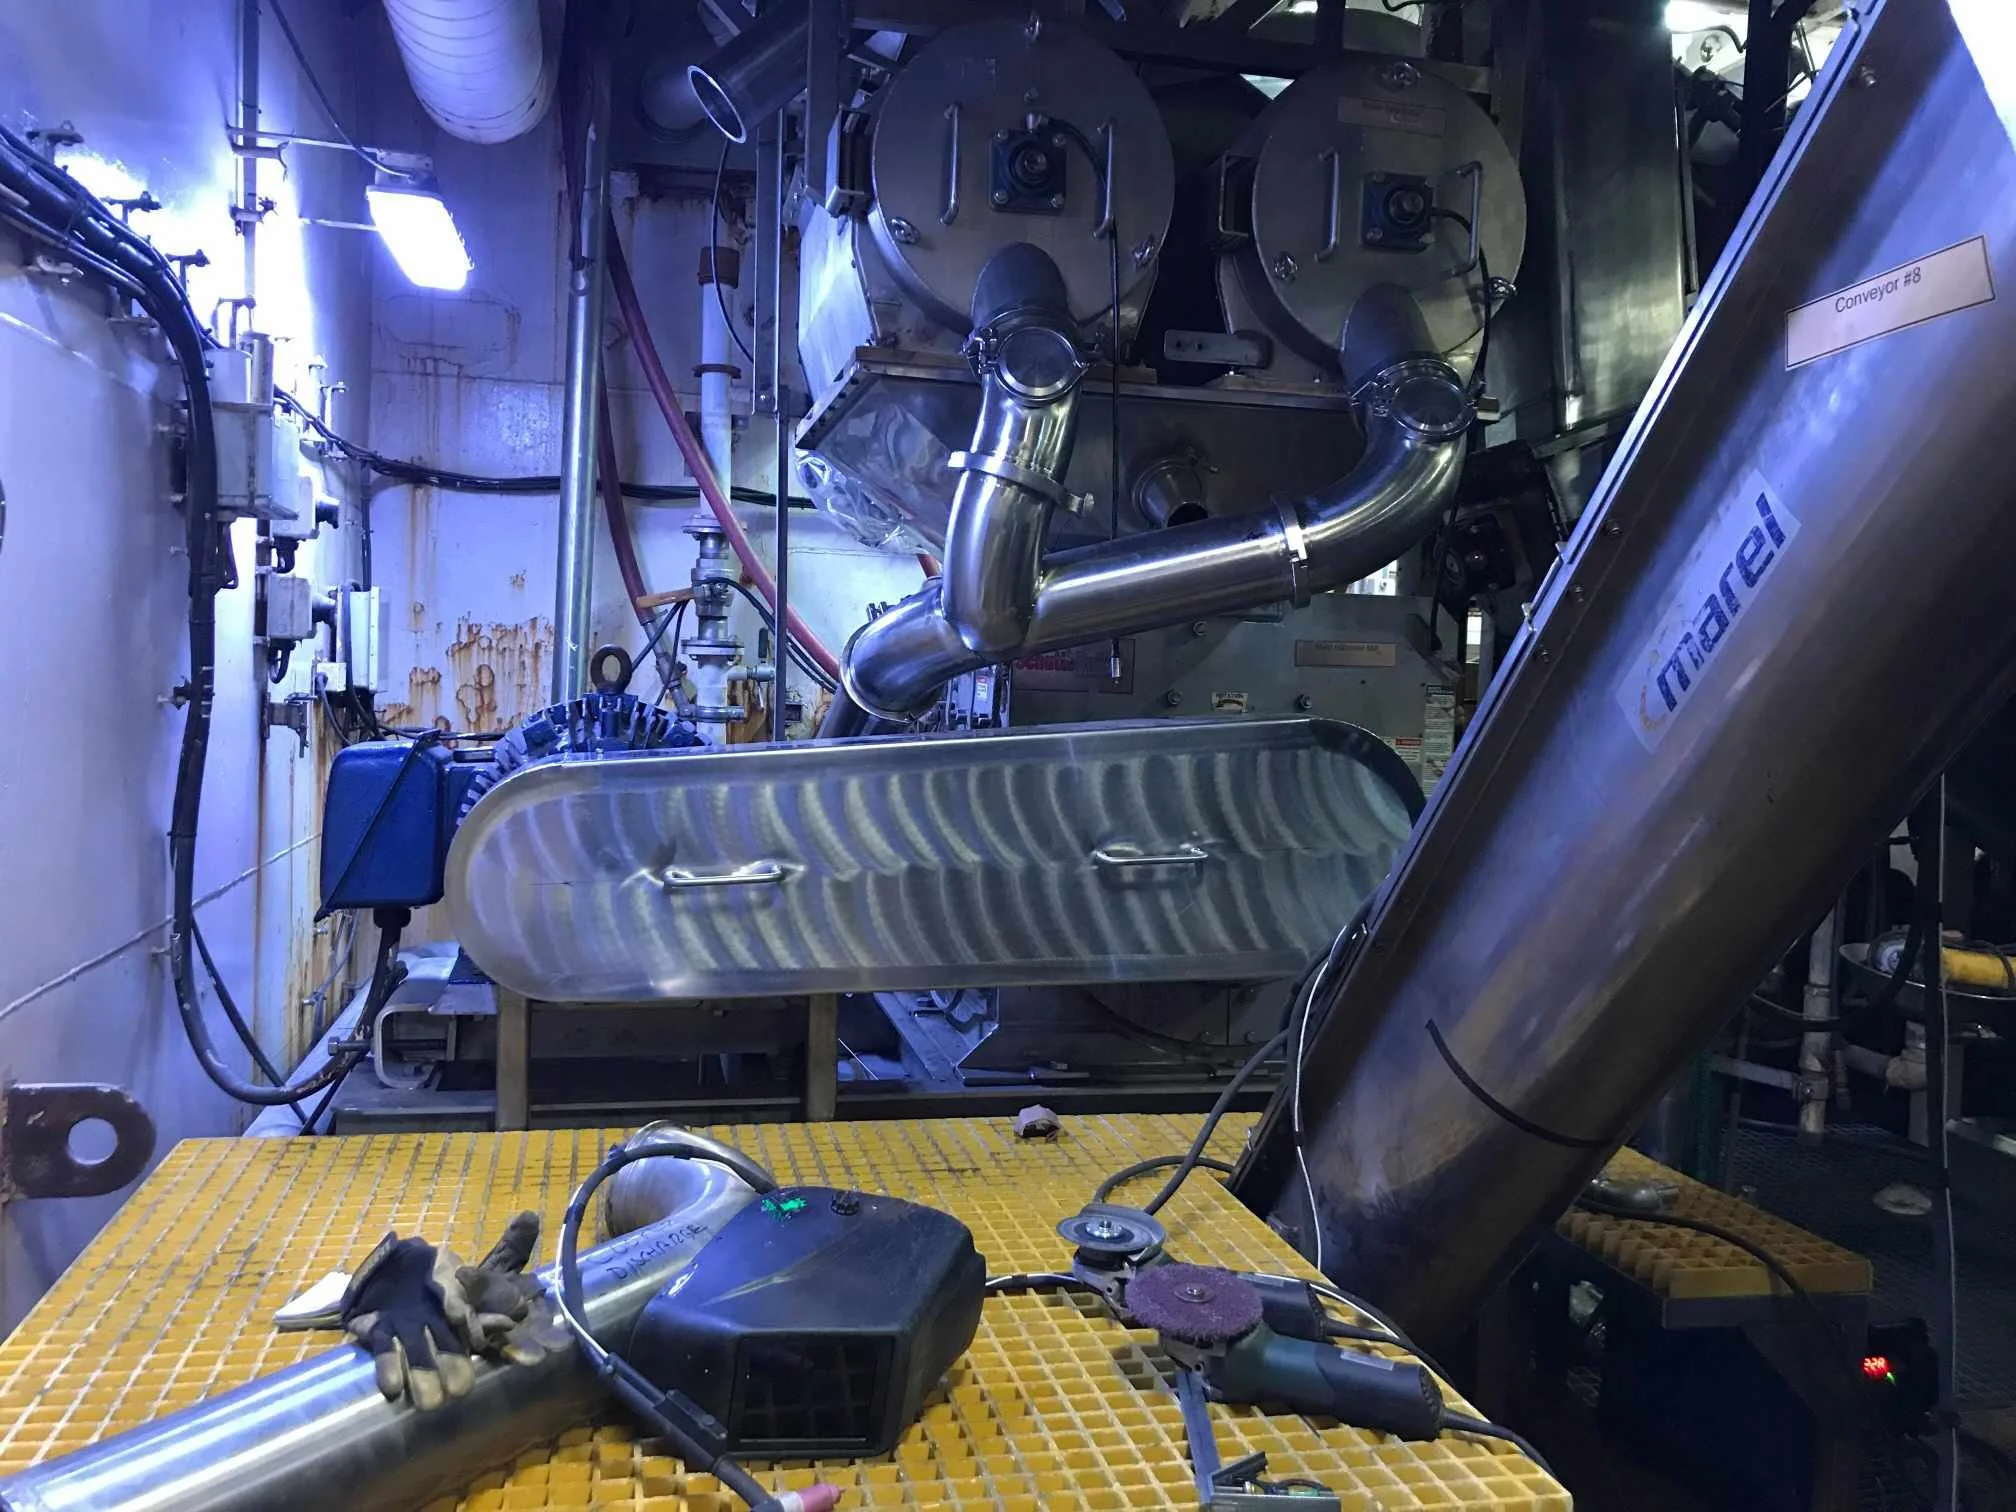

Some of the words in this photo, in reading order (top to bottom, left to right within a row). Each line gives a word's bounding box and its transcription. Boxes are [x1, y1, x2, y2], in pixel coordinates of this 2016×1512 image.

[1834, 278, 1899, 313] Conveyor
[1903, 267, 1922, 287] #8
[1656, 491, 1786, 713] marel
[606, 1224, 708, 1280] DISCHARGE
